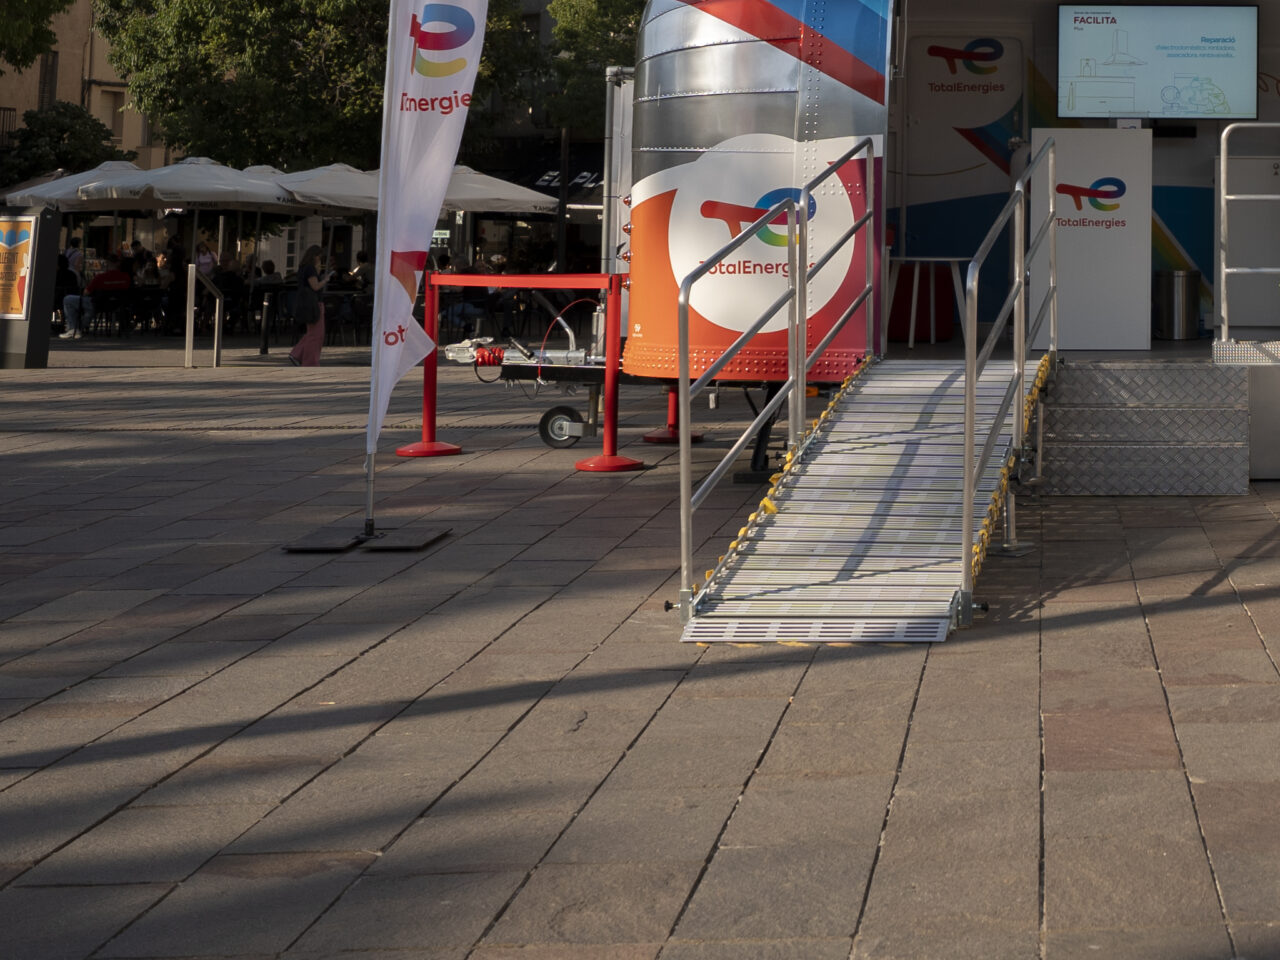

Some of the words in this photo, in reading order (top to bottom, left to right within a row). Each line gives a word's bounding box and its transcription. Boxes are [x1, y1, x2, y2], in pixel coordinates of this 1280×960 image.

[1073, 16, 1117, 25] FACILITA
[928, 82, 1005, 94] TotalEnergies
[1056, 218, 1126, 229] TotalEnergies
